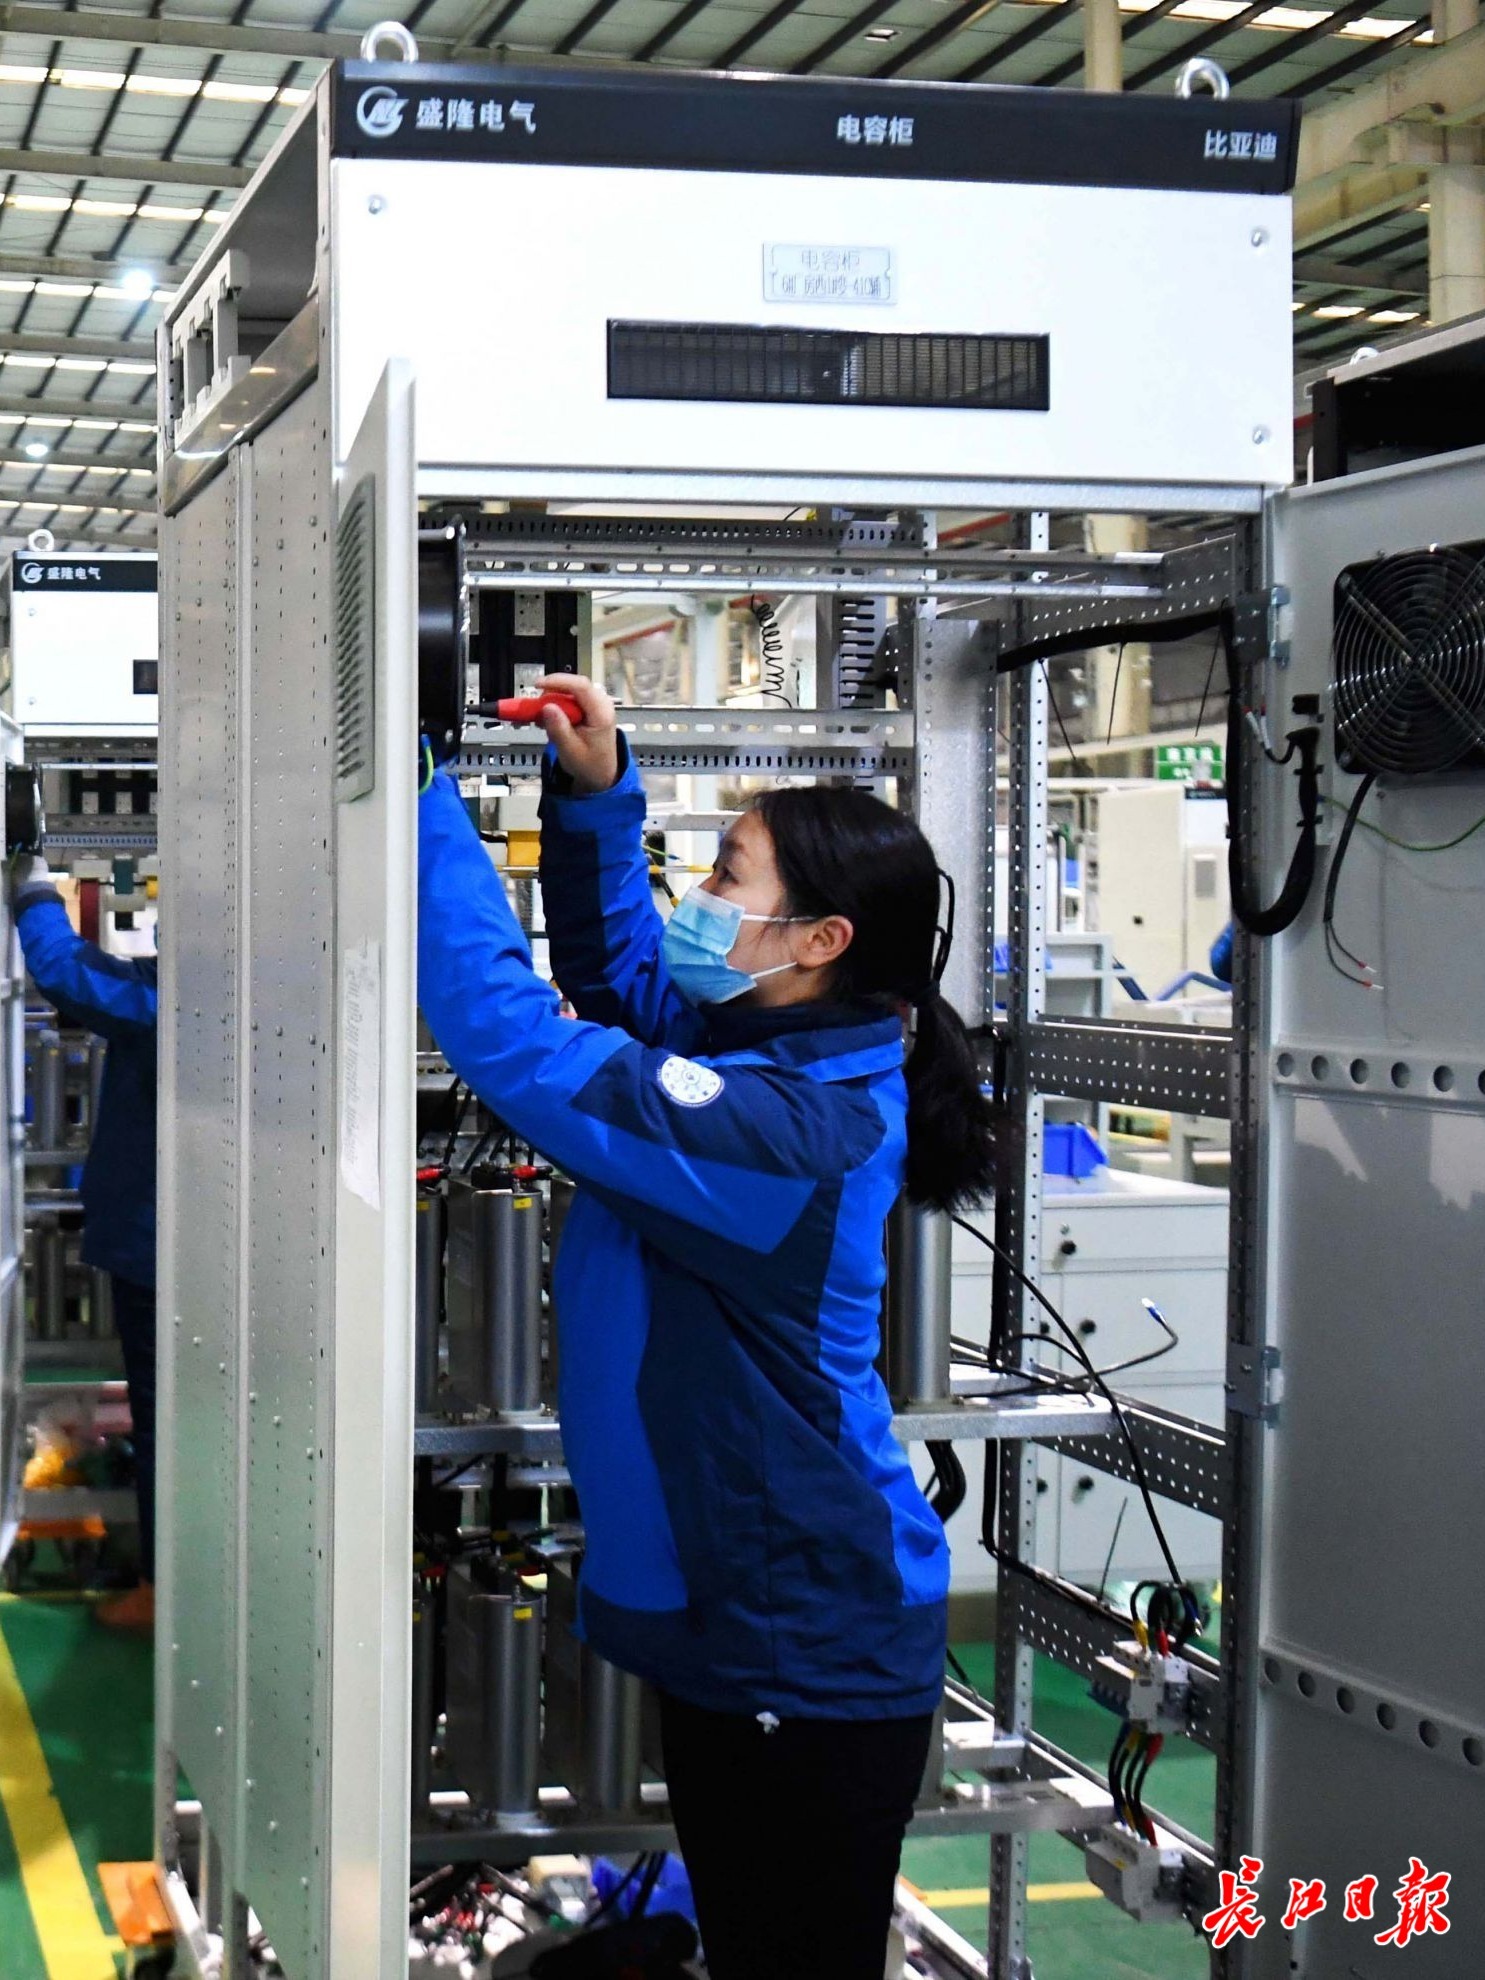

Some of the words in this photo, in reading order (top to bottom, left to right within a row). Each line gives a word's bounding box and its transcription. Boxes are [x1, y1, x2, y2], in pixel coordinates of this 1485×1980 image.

[415, 97, 537, 134] 盛隆电气
[837, 114, 915, 145] 电容柜
[1203, 129, 1278, 160] 比亚迪
[801, 249, 861, 271] 电容柜
[47, 566, 101, 580] 盛隆电气
